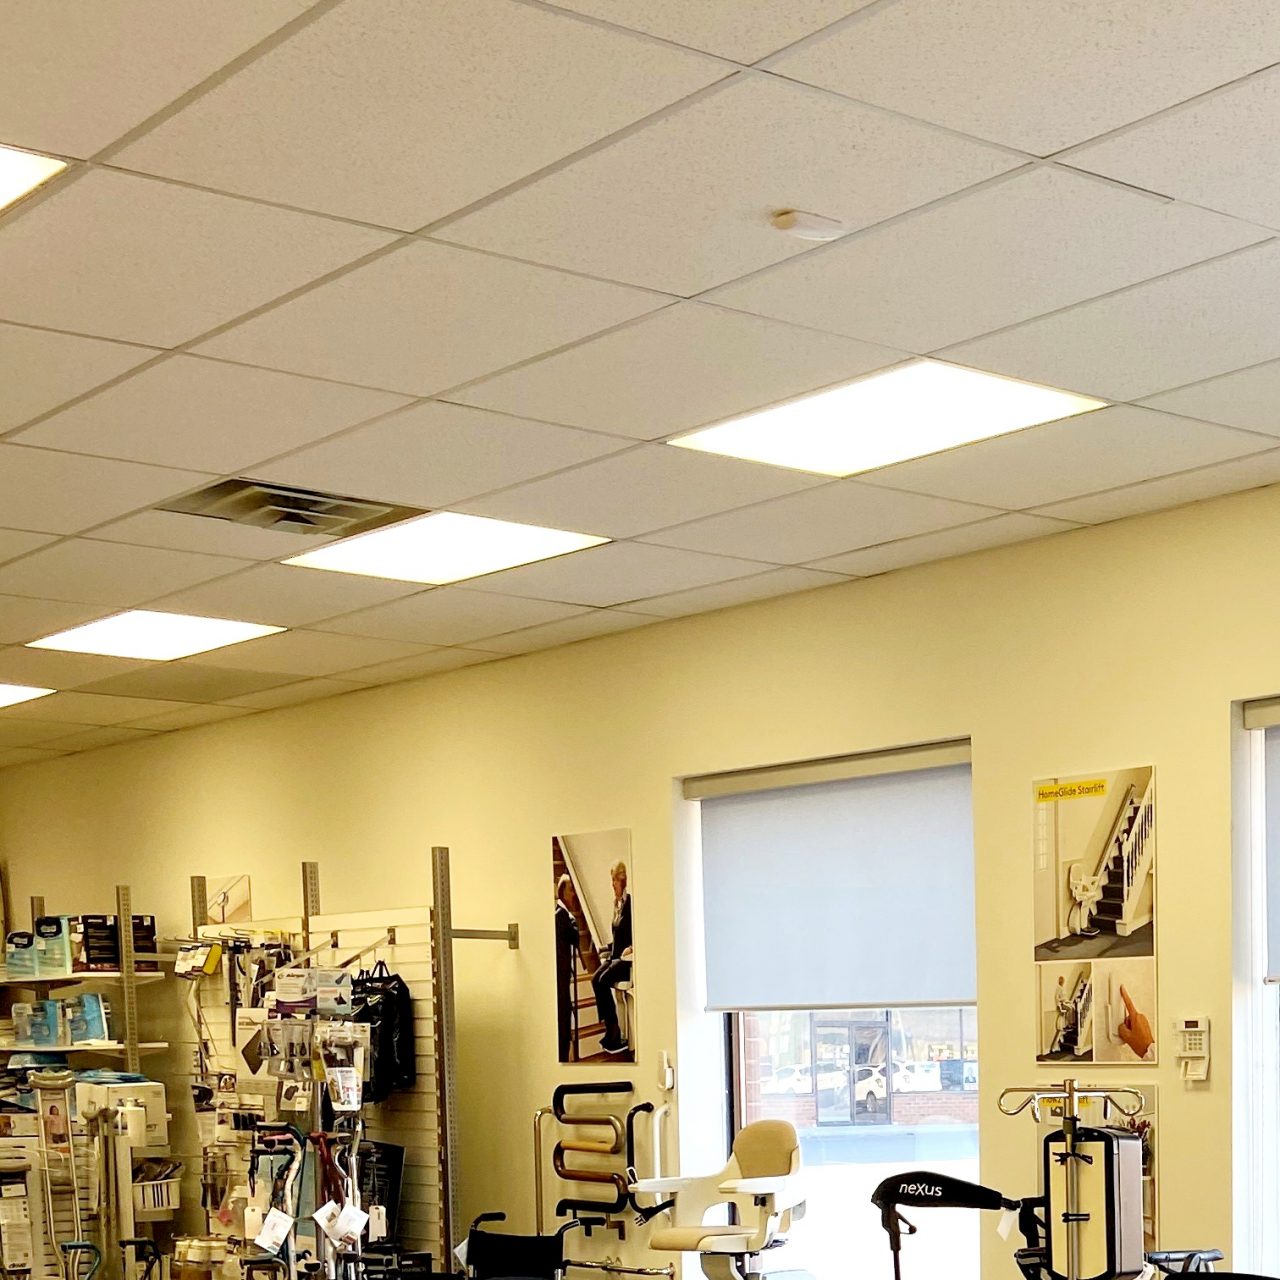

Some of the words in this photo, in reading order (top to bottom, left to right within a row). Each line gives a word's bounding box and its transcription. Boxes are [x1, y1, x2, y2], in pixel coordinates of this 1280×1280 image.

[1038, 786, 1077, 800] HomeGlide
[1077, 783, 1105, 796] Stairlift
[898, 1183, 943, 1197] neXus
